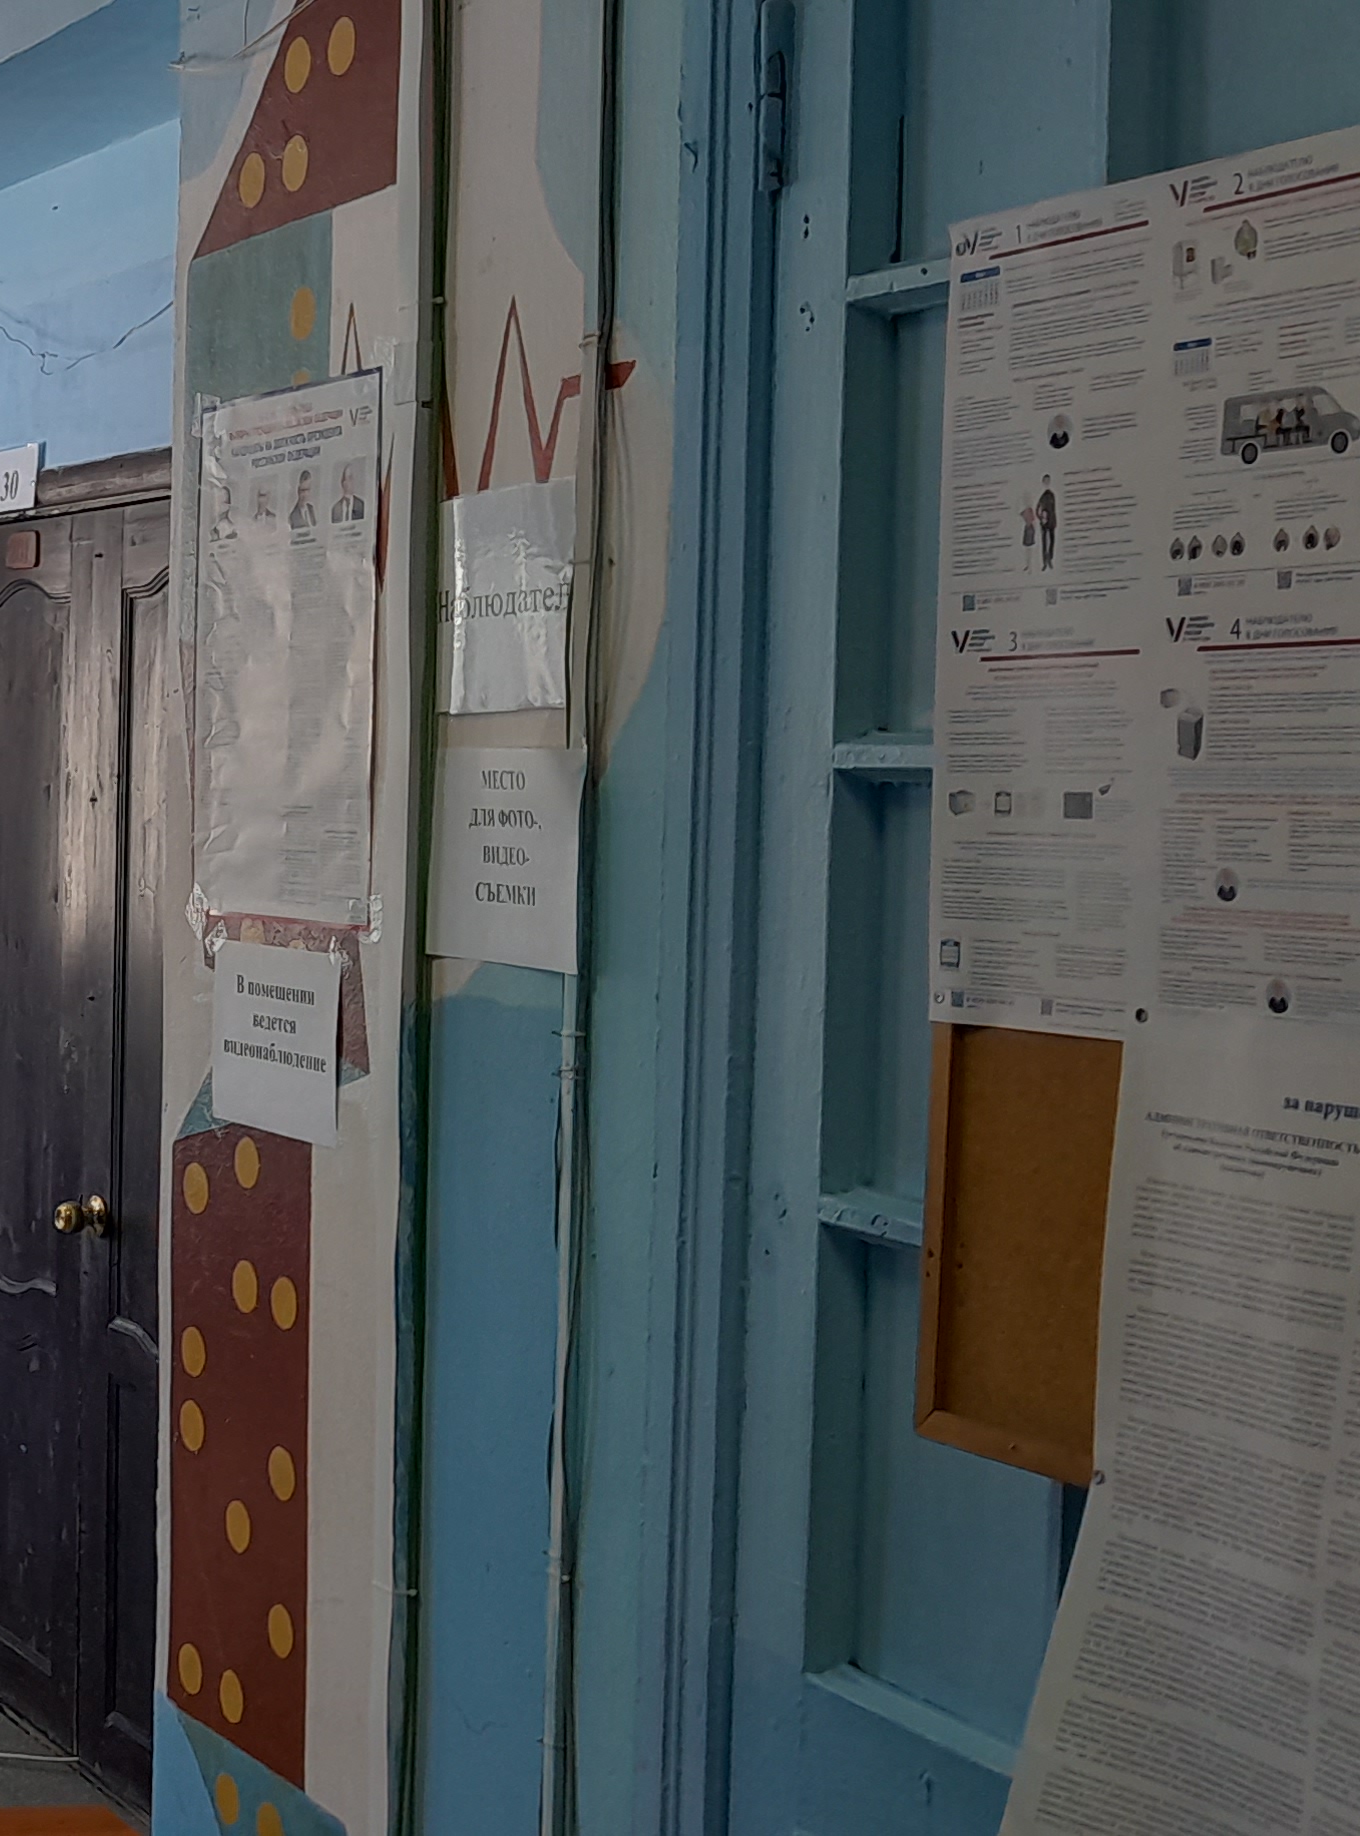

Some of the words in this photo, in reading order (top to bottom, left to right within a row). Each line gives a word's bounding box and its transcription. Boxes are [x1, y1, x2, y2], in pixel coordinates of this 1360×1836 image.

[1233, 173, 1245, 195] 2
[1016, 224, 1022, 244] 1
[0, 470, 19, 502] 30
[1230, 617, 1242, 640] 4
[1008, 631, 1018, 652] 3
[481, 770, 526, 790] МЕСТО
[468, 808, 495, 829] ДЛЯ
[482, 845, 530, 866] ВИДЕО-
[475, 881, 536, 907] СЪЕМКИ
[236, 974, 244, 994] В
[247, 981, 315, 1006] помещении
[252, 1013, 297, 1035] ведется
[223, 1038, 327, 1073] видеонаблюдение
[1283, 1096, 1300, 1111] за
